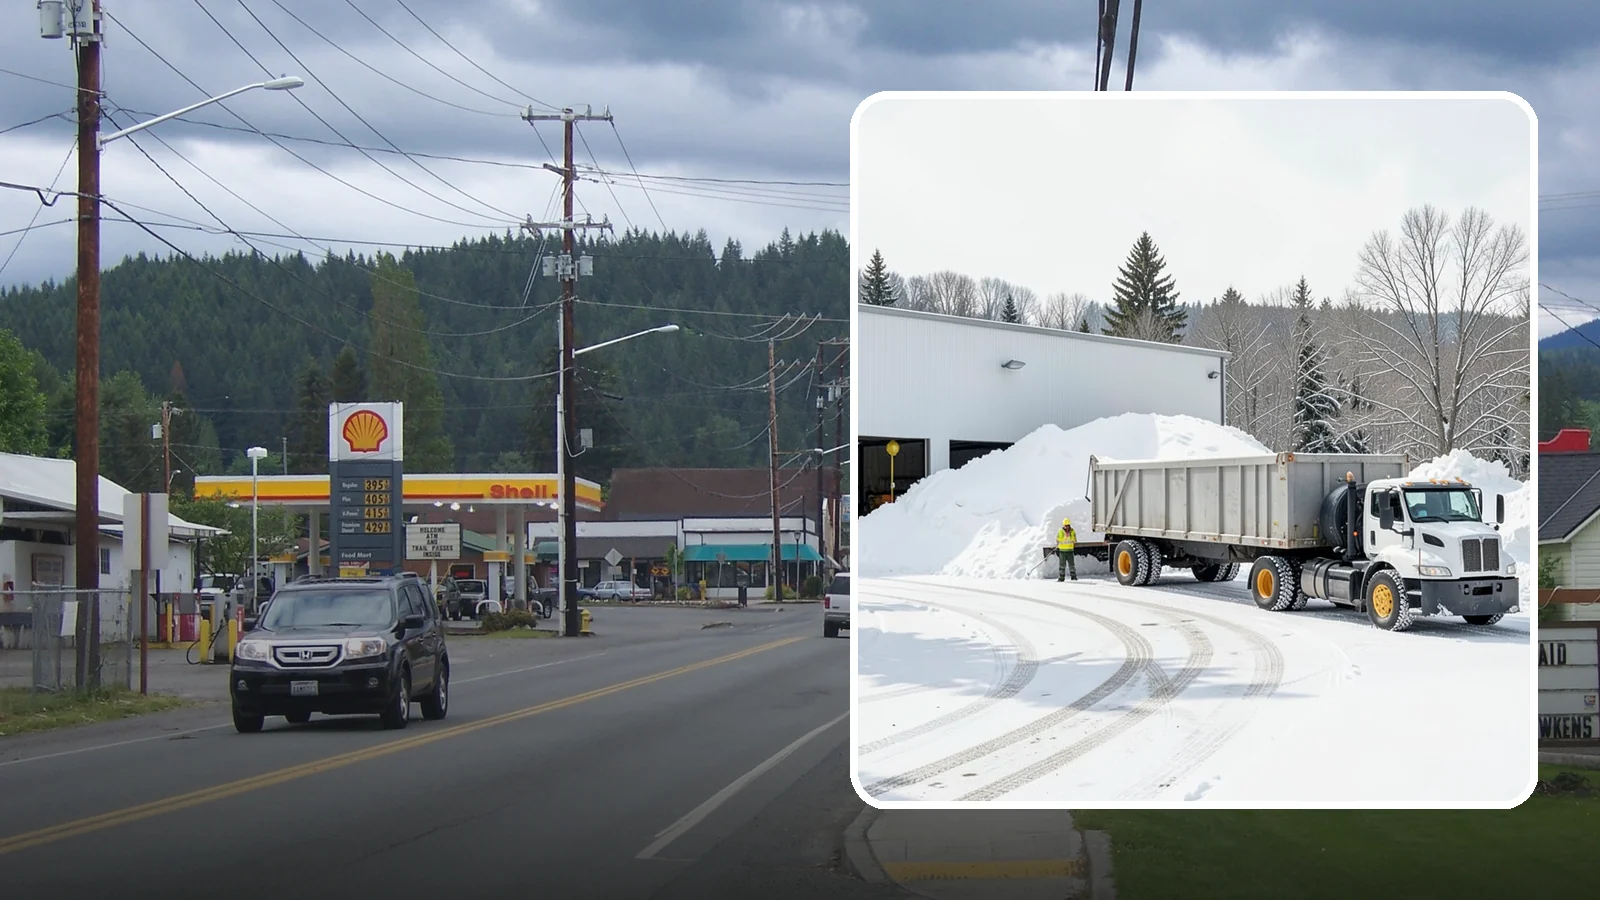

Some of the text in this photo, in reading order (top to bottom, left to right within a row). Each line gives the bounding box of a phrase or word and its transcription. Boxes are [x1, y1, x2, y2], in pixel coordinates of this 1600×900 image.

[366, 480, 383, 490] 395
[490, 484, 547, 499] Shell
[366, 494, 383, 504] 405
[366, 508, 383, 518] 415
[366, 522, 383, 532] 429
